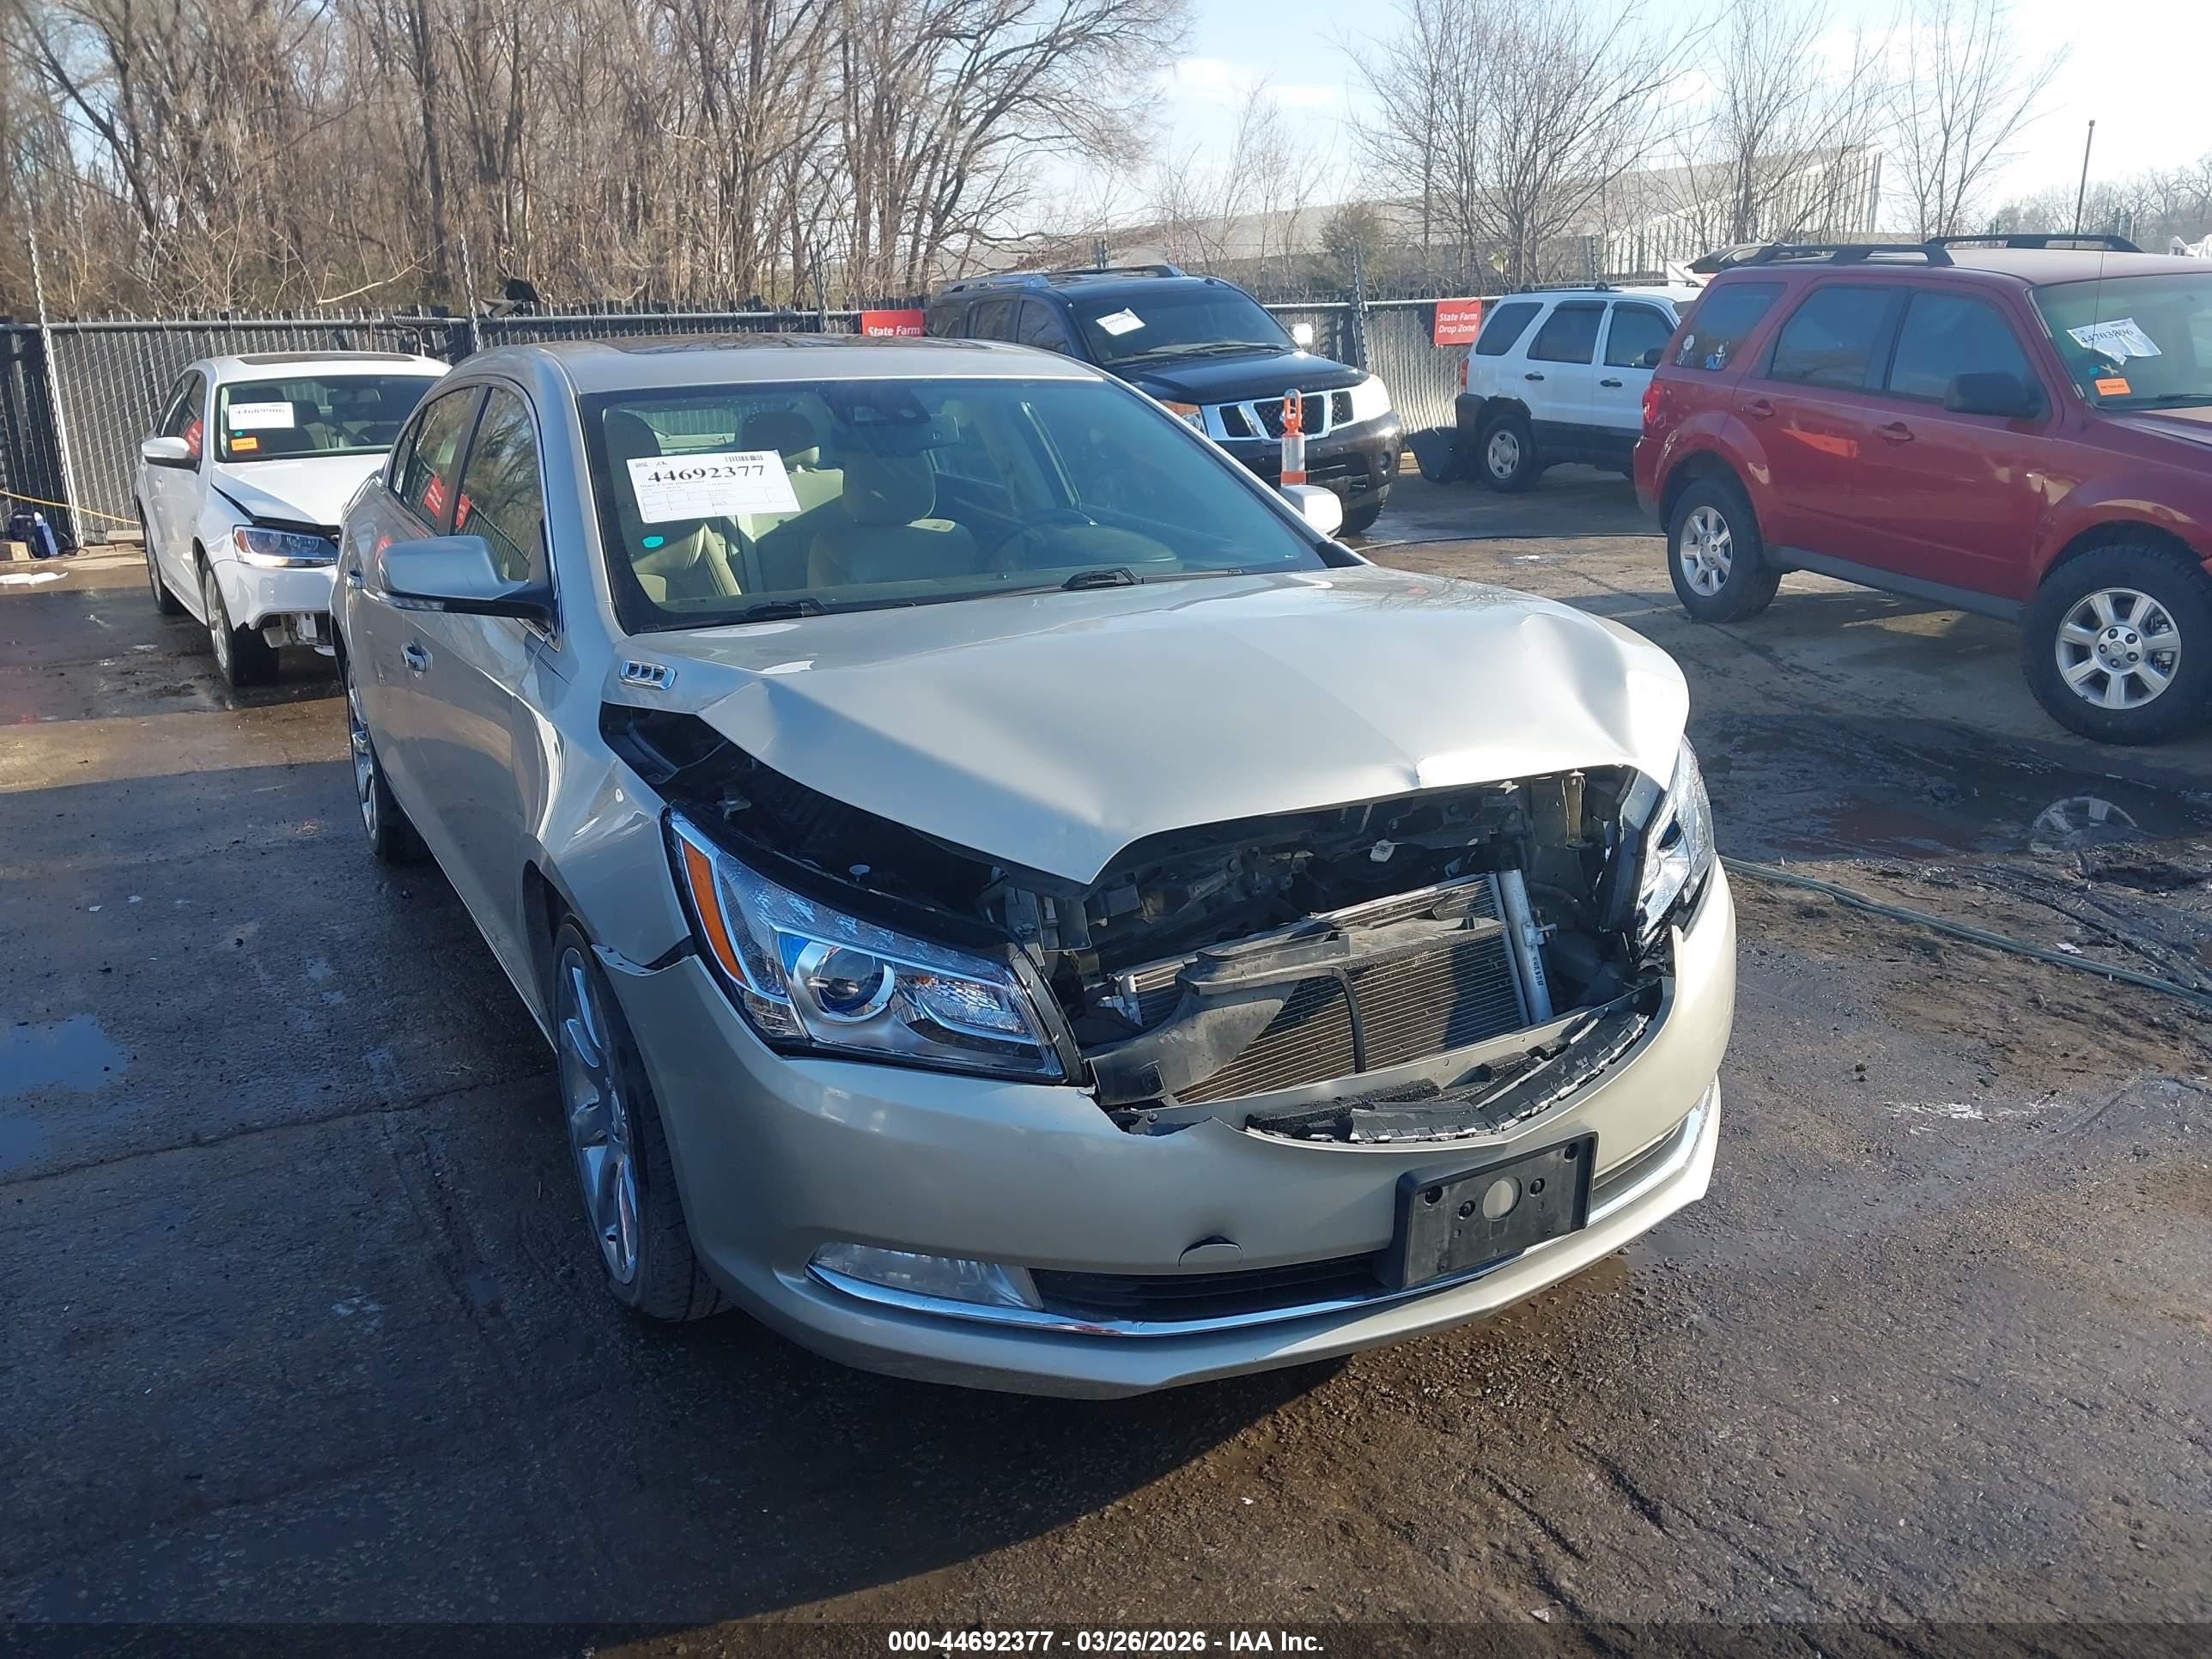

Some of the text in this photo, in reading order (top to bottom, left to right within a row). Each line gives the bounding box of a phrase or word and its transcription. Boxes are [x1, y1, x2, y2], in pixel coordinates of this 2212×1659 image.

[1437, 312, 1477, 322] State Farm
[867, 325, 921, 336] State Farm
[1438, 324, 1476, 335] Drop Zone
[647, 465, 764, 483] 44692377
